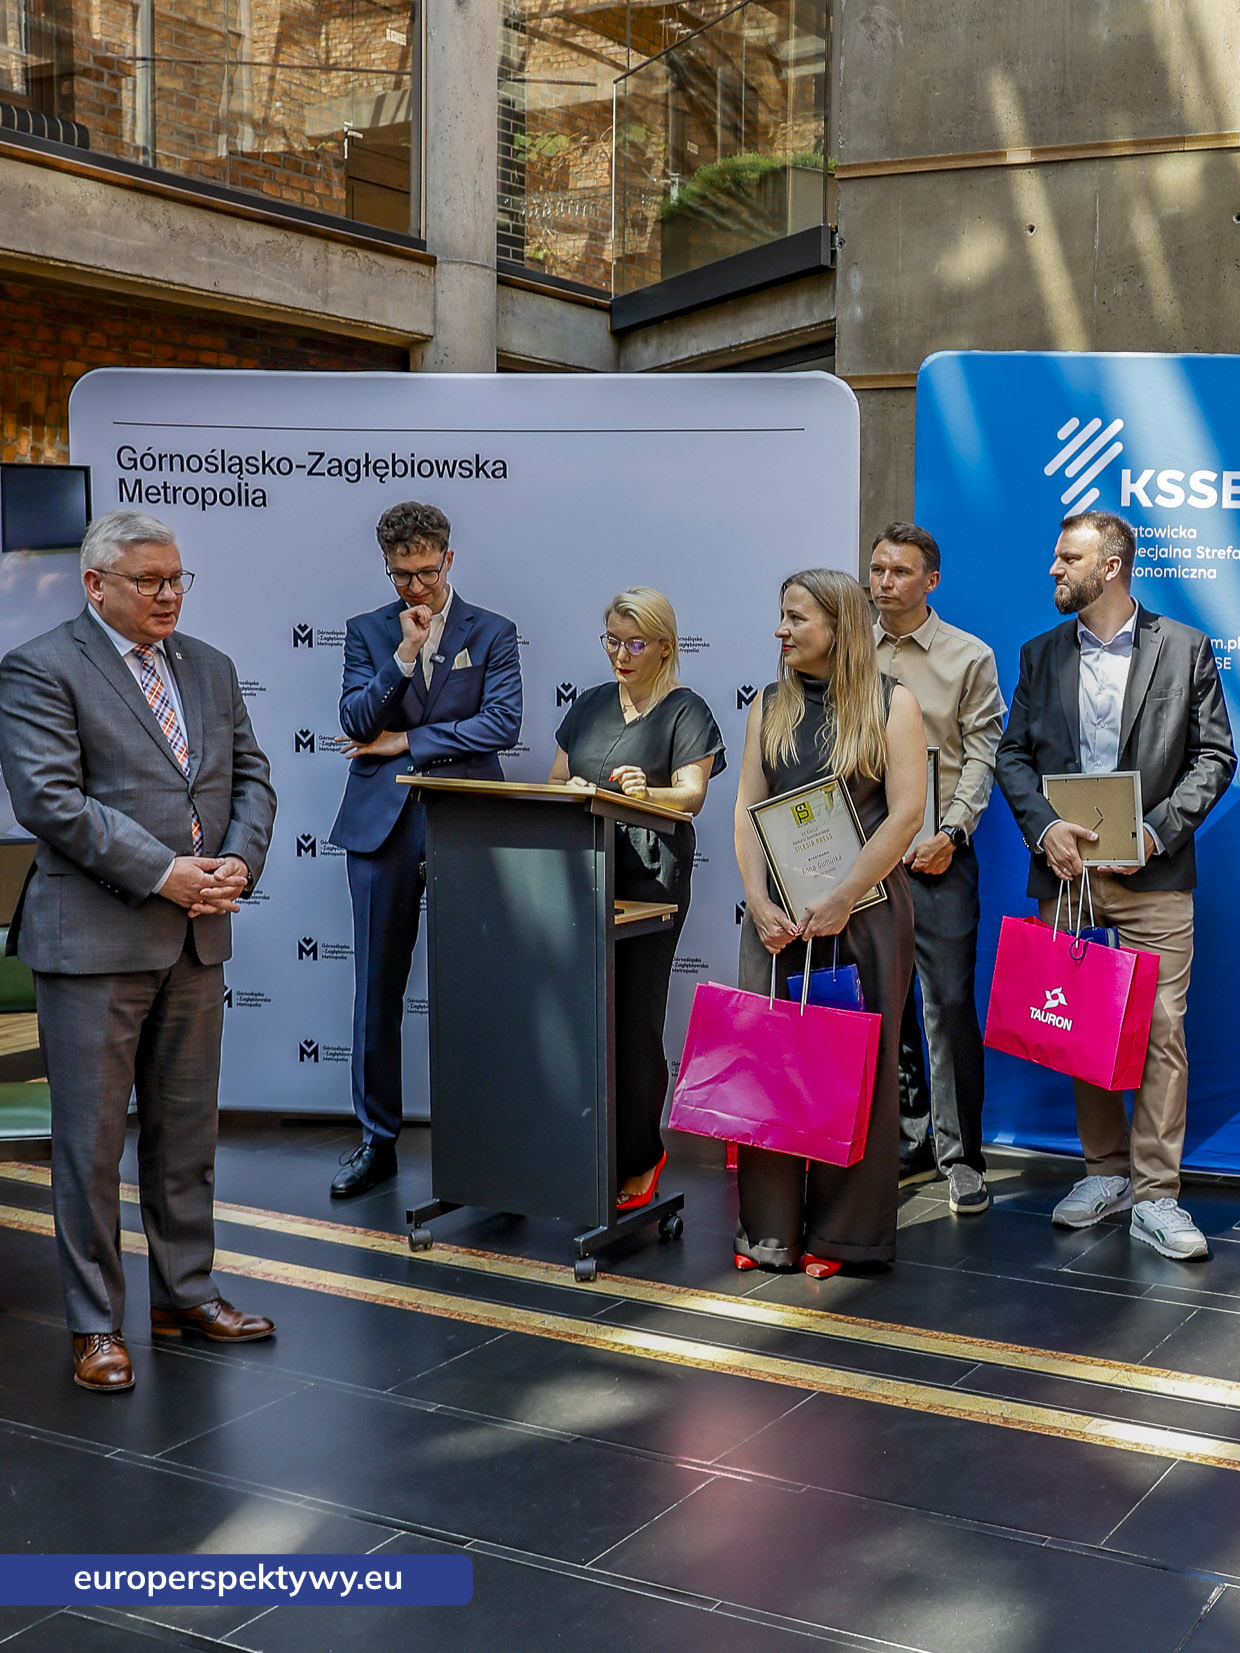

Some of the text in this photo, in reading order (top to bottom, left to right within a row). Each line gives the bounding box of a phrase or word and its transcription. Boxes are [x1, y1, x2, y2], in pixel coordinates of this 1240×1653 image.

[116, 445, 508, 483] Górnośląsko-Zagłębiowska
[118, 478, 268, 511] Metropolia
[1131, 525, 1197, 539] atowicka
[1134, 544, 1192, 561] ecjalna
[1131, 565, 1217, 579] onomiczna
[816, 833, 833, 845] PRESS
[1029, 1006, 1073, 1031] TAURON
